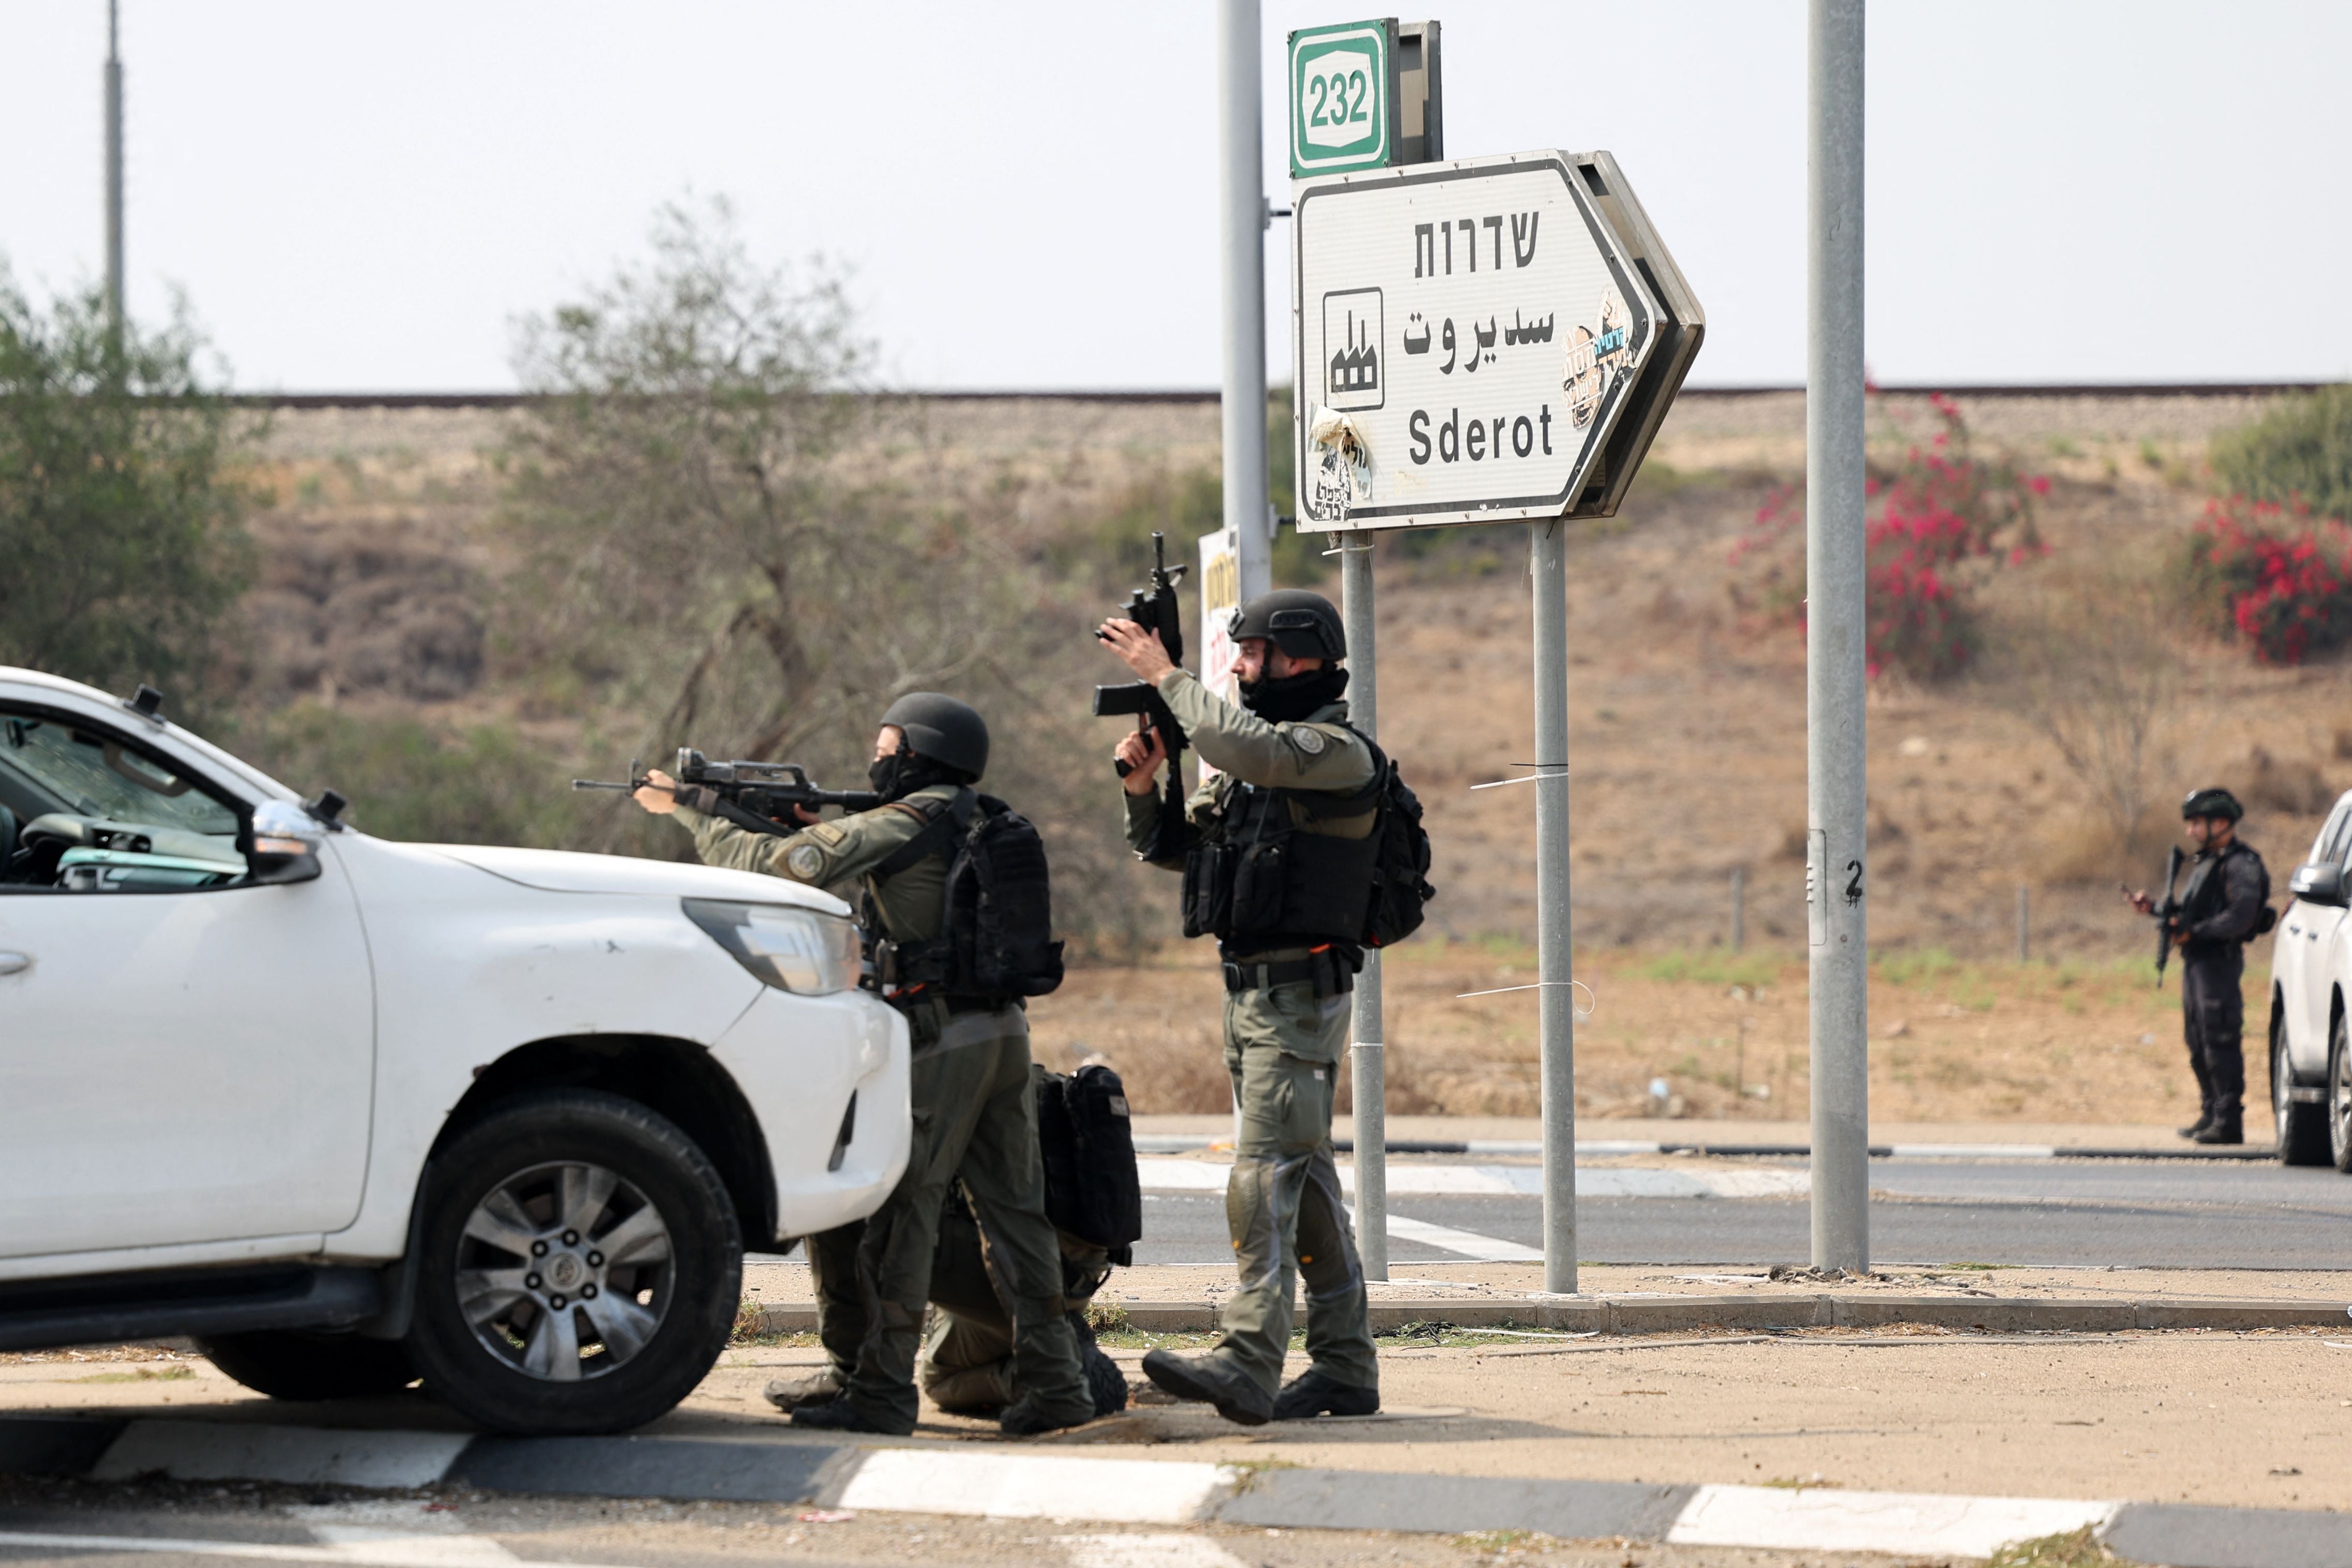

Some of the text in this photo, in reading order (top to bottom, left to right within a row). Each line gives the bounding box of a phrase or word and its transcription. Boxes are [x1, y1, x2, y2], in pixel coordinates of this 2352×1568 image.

[1310, 70, 1367, 127] 232
[1415, 212, 1539, 278] שדרות
[1404, 309, 1554, 375] سديروت
[1410, 405, 1552, 465] Sderot
[1846, 860, 1862, 899] 2
